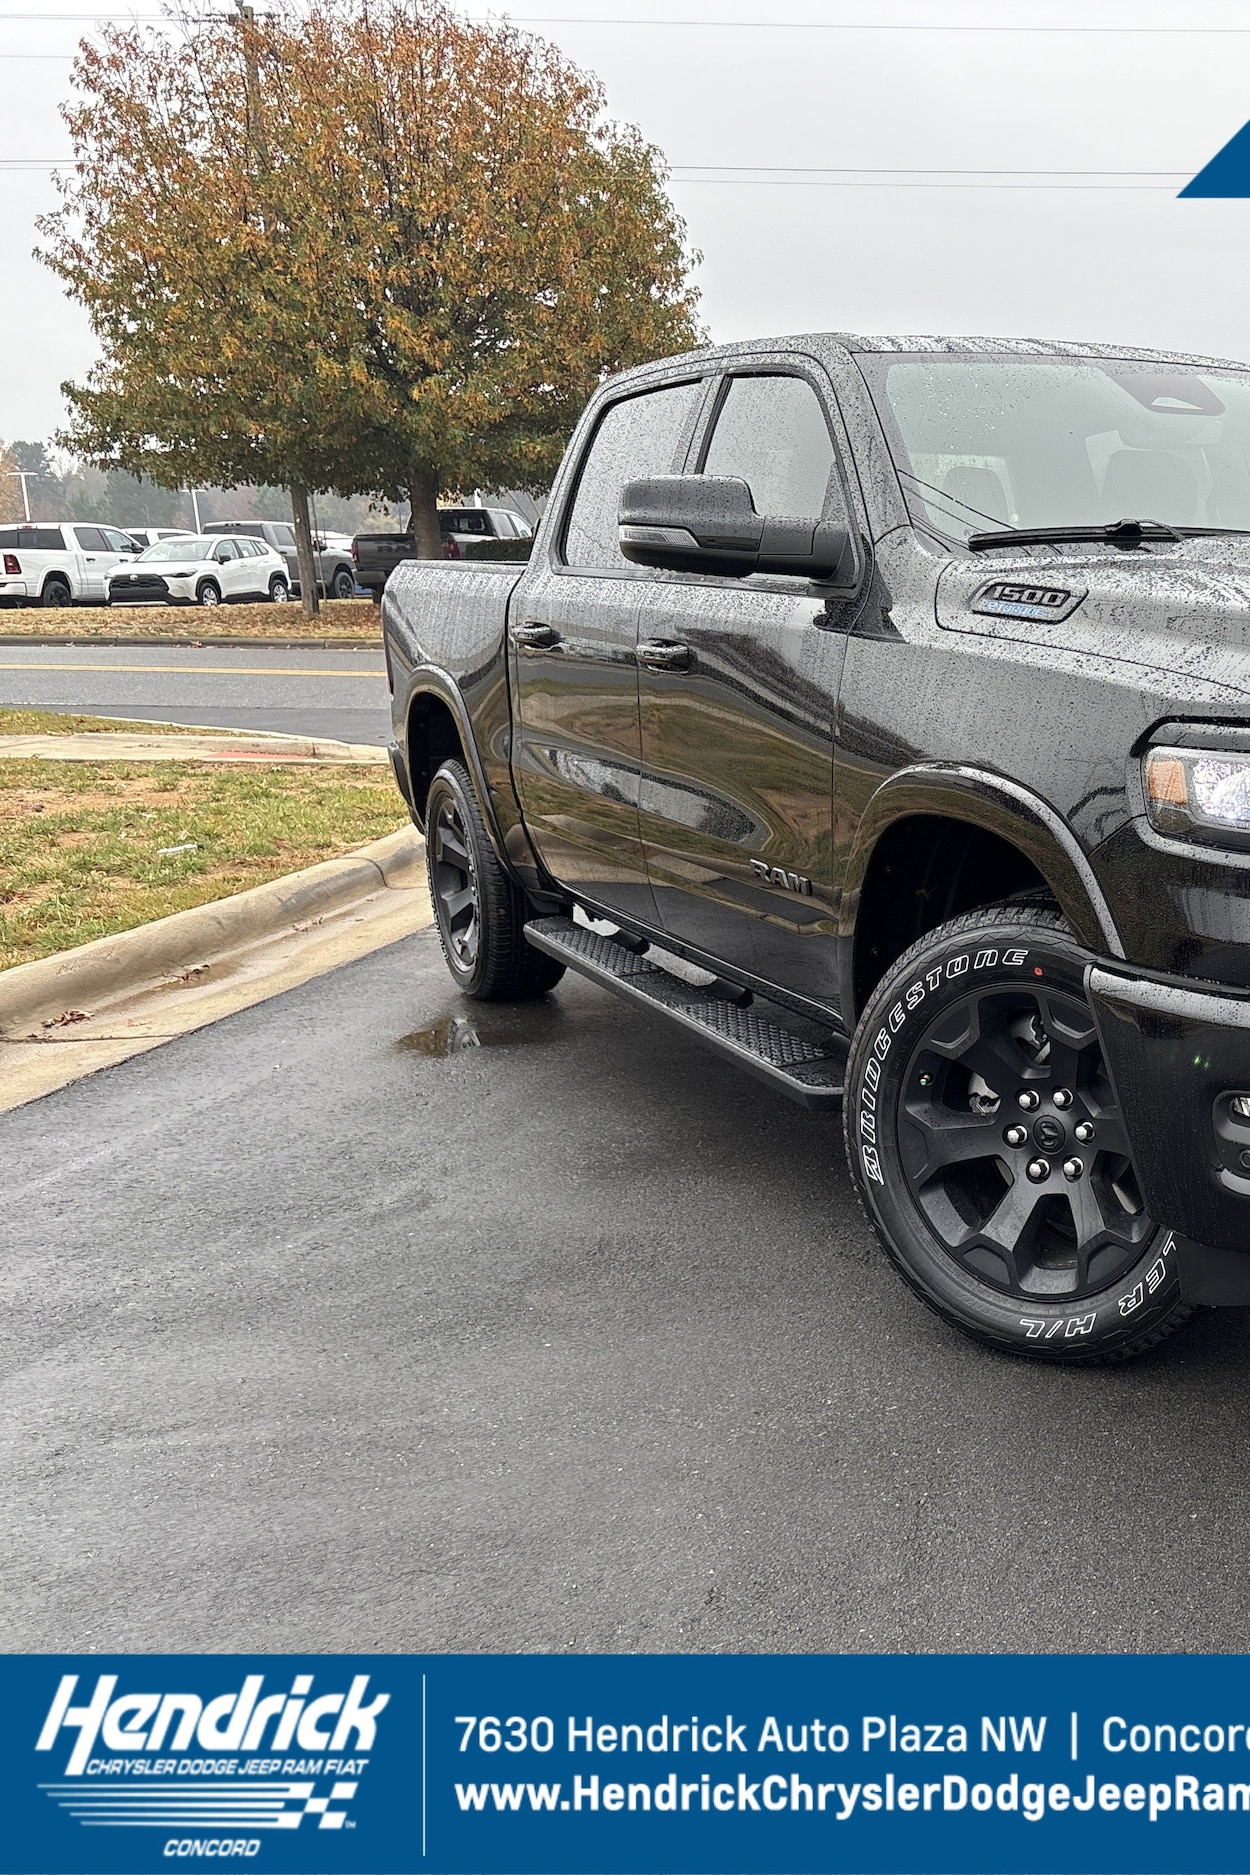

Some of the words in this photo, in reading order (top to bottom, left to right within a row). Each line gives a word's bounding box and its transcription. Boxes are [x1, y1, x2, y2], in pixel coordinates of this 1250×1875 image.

[992, 585, 1067, 606] 1500
[749, 858, 814, 896] RAM
[860, 948, 1029, 1186] BRIDGESTONE
